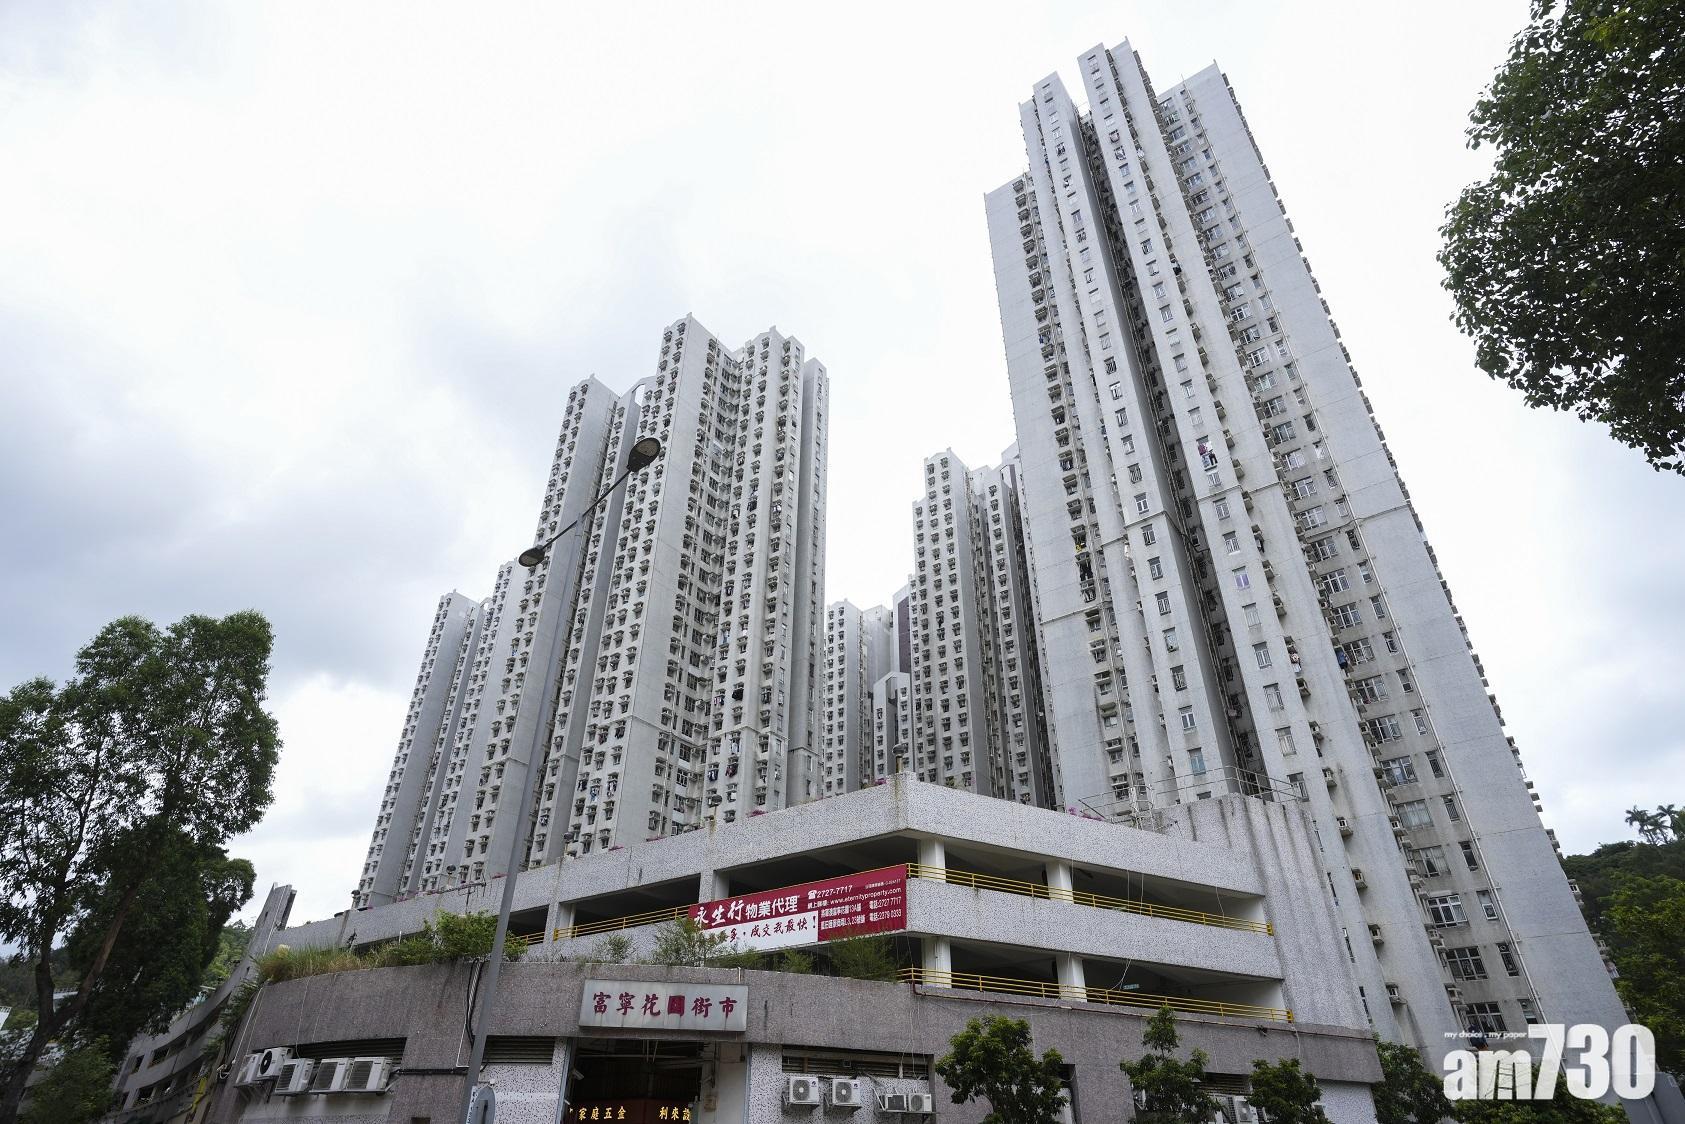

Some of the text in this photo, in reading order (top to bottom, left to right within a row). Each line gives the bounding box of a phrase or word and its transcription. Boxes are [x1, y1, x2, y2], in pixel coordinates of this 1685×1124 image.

[830, 888, 902, 905] www.eternityproperty.com
[693, 896, 798, 929] 永生行物業代理
[592, 992, 738, 1018] 富寧花園街市
